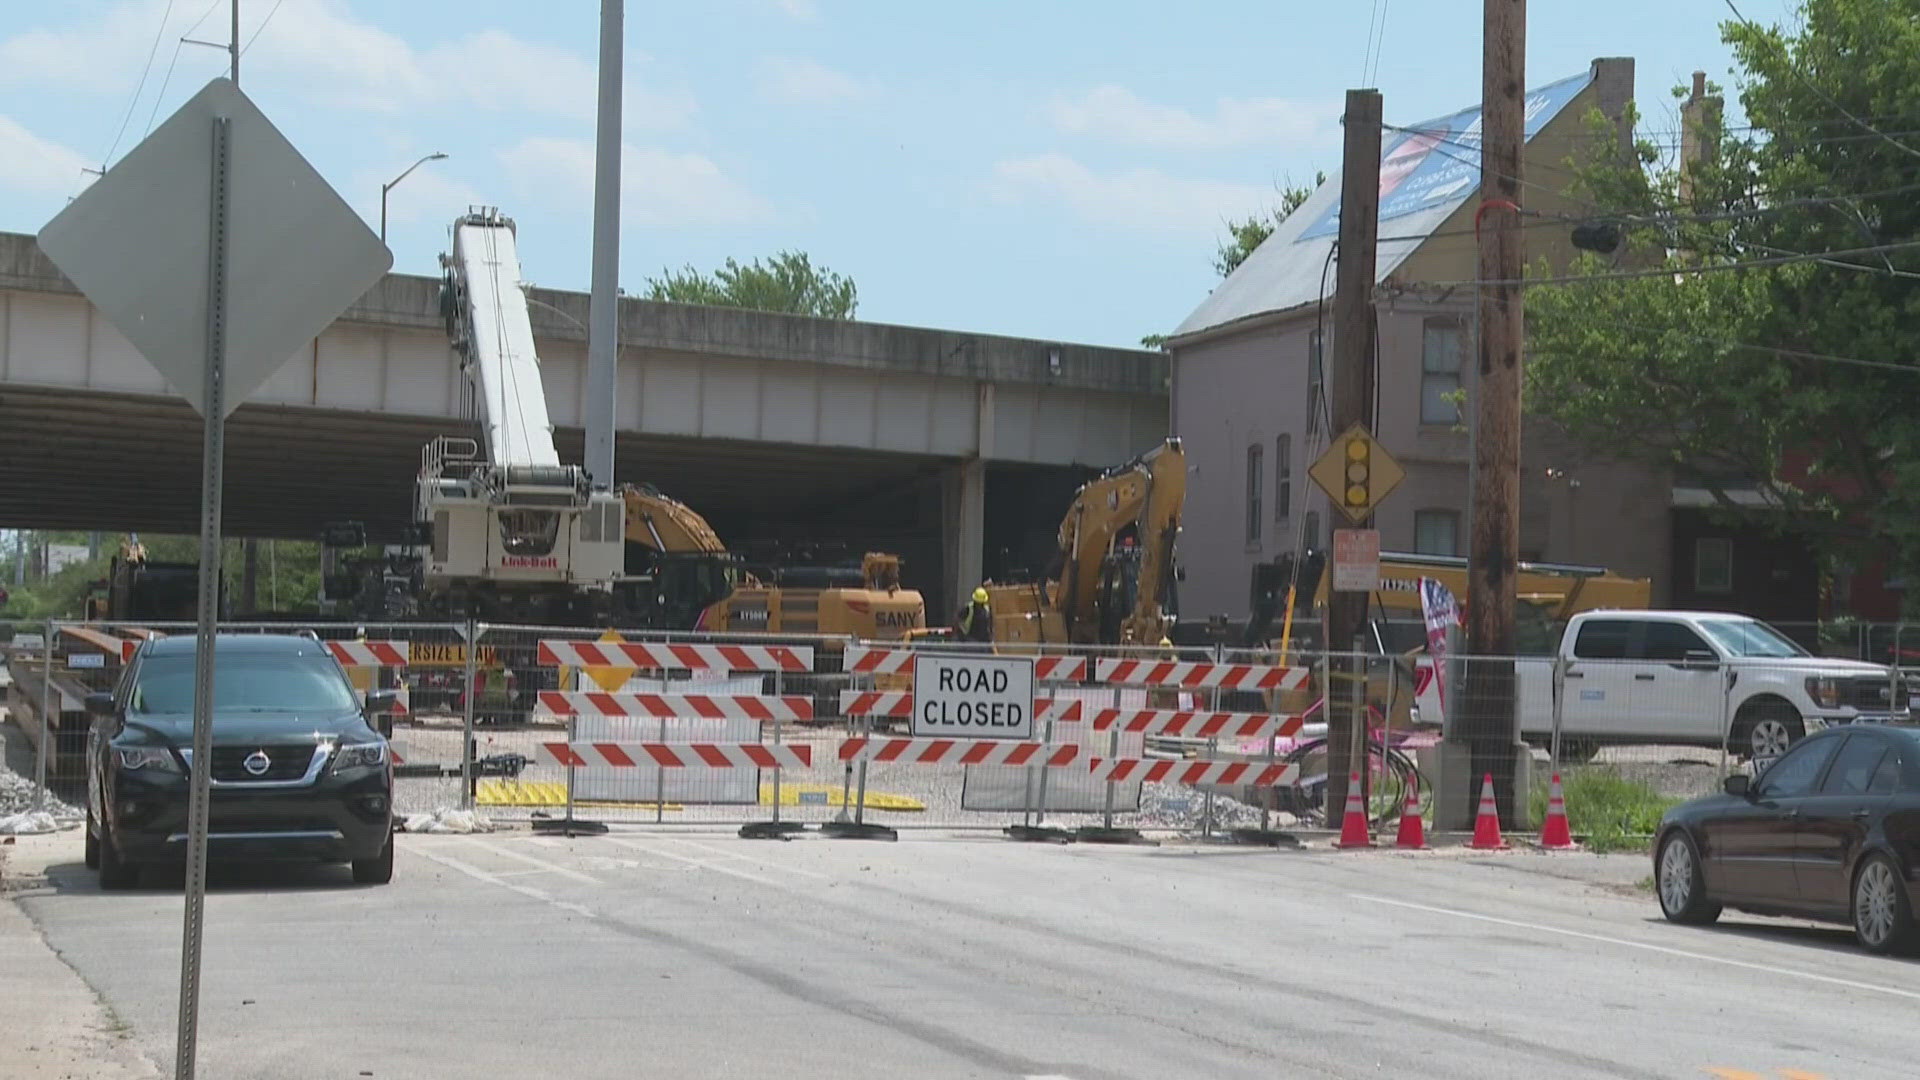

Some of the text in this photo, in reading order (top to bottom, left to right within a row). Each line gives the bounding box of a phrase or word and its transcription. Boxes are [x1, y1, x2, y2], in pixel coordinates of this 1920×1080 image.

[501, 556, 558, 569] Link-Belt
[875, 611, 917, 628] SANY
[458, 645, 496, 663] LAD
[939, 667, 1009, 693] ROAD
[924, 700, 1022, 727] CLOSED
